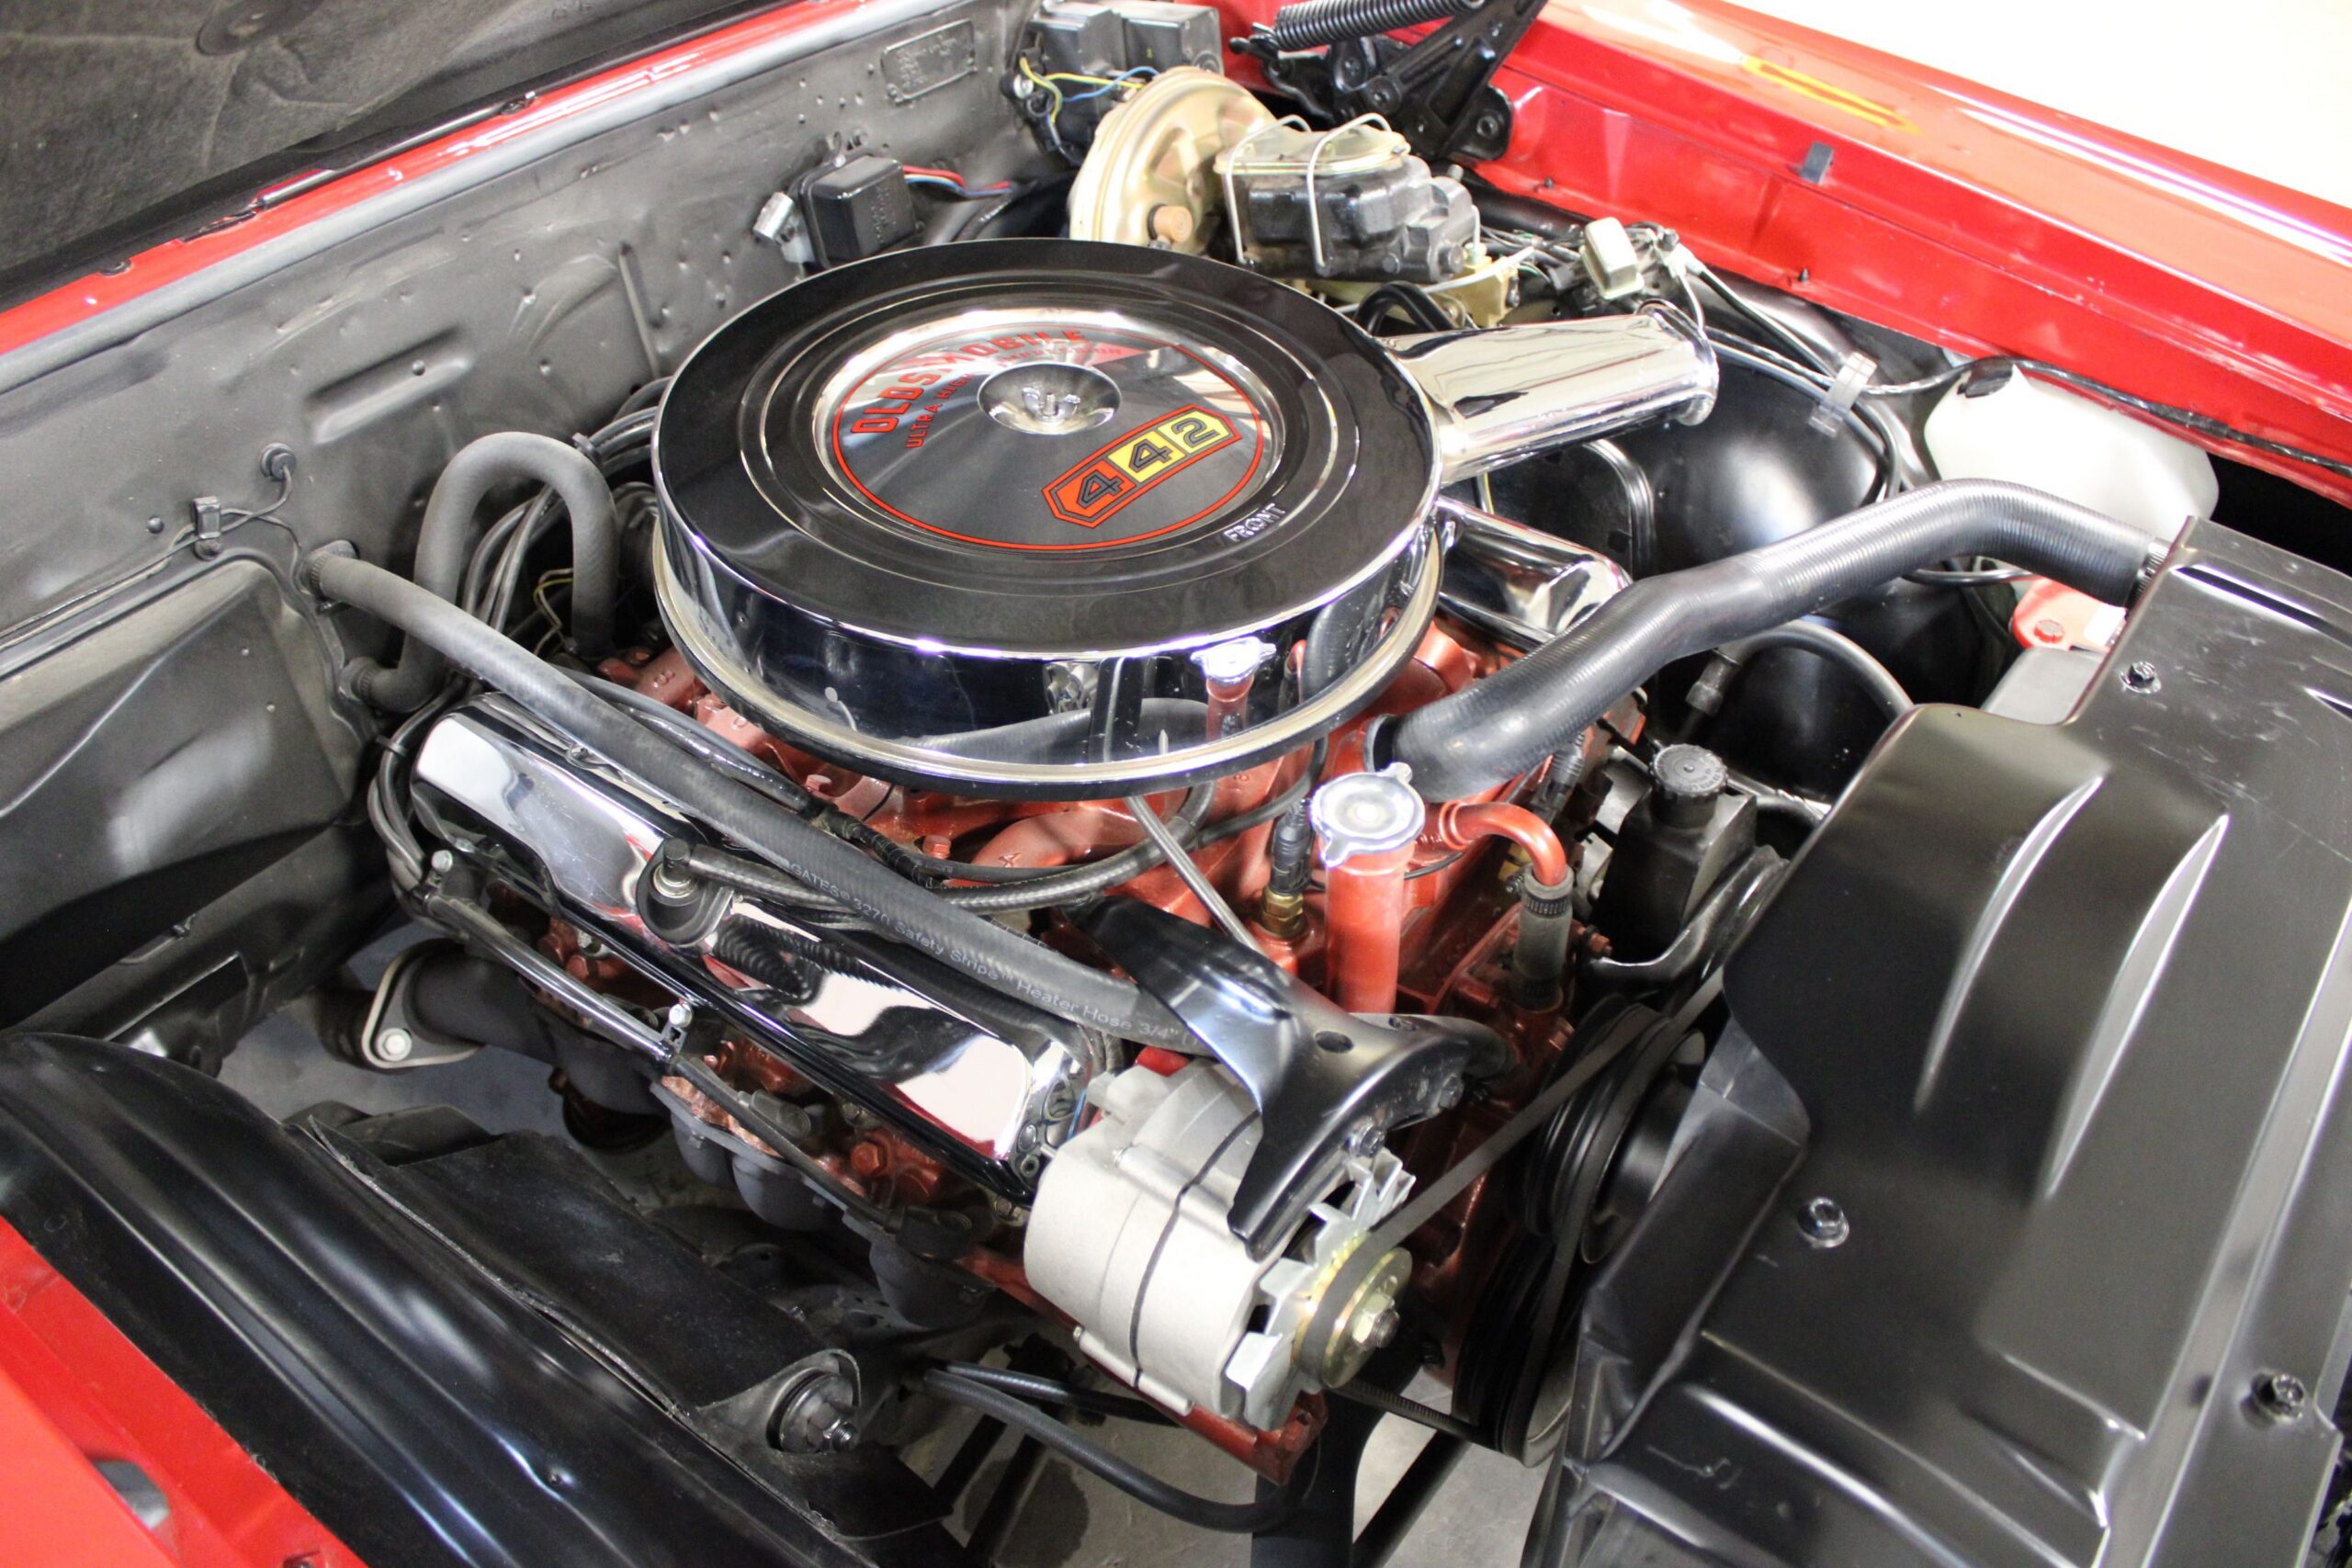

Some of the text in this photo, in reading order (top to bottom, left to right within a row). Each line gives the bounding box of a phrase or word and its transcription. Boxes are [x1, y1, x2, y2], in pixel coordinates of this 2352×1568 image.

[851, 330, 1089, 434] OLDSMOBILE
[904, 402, 944, 449] ULTRA
[1223, 502, 1286, 543] FRONT
[894, 920, 944, 956] Safety
[1016, 980, 1080, 1013] Heater
[1082, 1004, 1132, 1030] Hose
